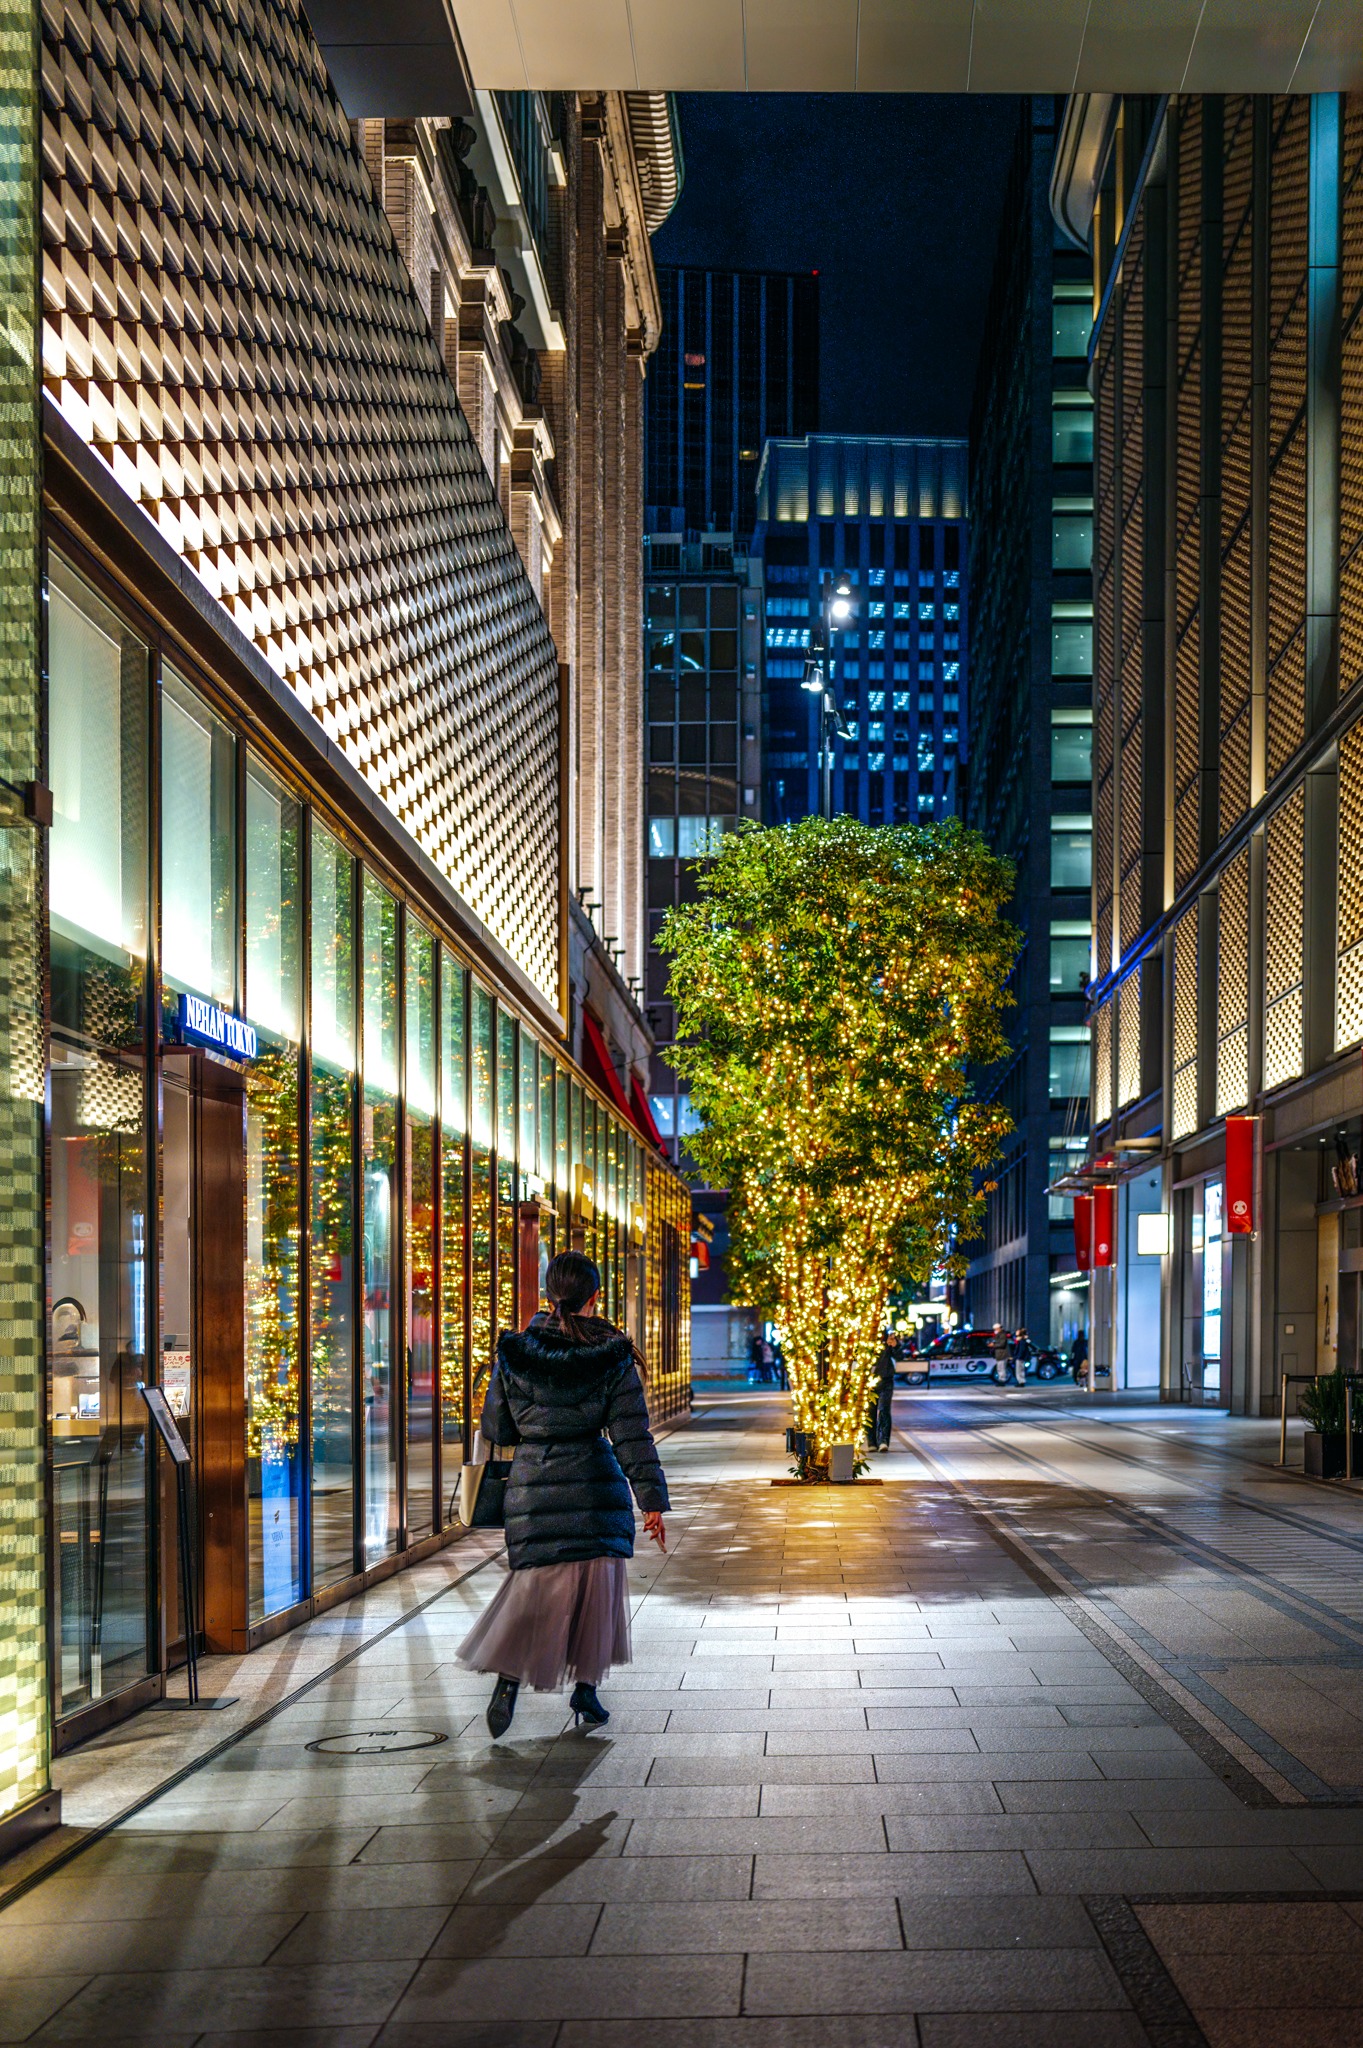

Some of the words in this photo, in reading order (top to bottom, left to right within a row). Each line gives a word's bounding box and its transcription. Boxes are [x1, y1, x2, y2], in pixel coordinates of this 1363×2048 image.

[186, 993, 225, 1043] NEHAN
[224, 1015, 257, 1058] TOKYO
[939, 1362, 959, 1370] TAXI
[965, 1360, 987, 1373] GO
